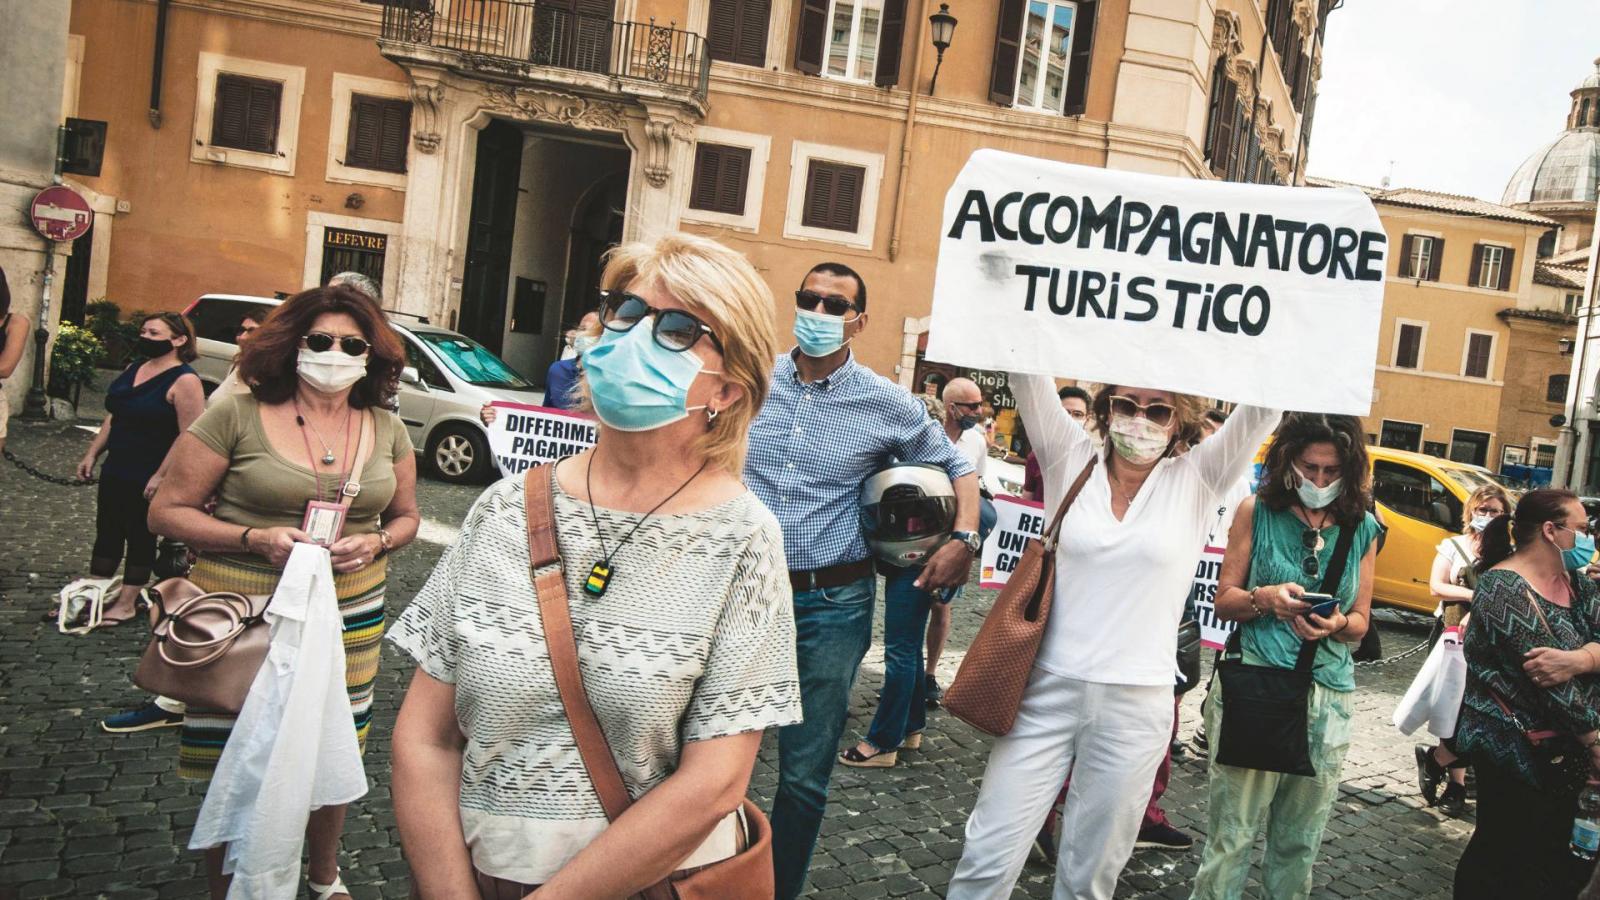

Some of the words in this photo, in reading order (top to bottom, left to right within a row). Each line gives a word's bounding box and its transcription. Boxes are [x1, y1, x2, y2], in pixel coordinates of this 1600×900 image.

[328, 231, 384, 249] LEFEVRE
[947, 189, 1387, 281] ACCOMPAGNATORE
[970, 371, 1005, 389] Shop
[511, 436, 590, 460] PAGAM
